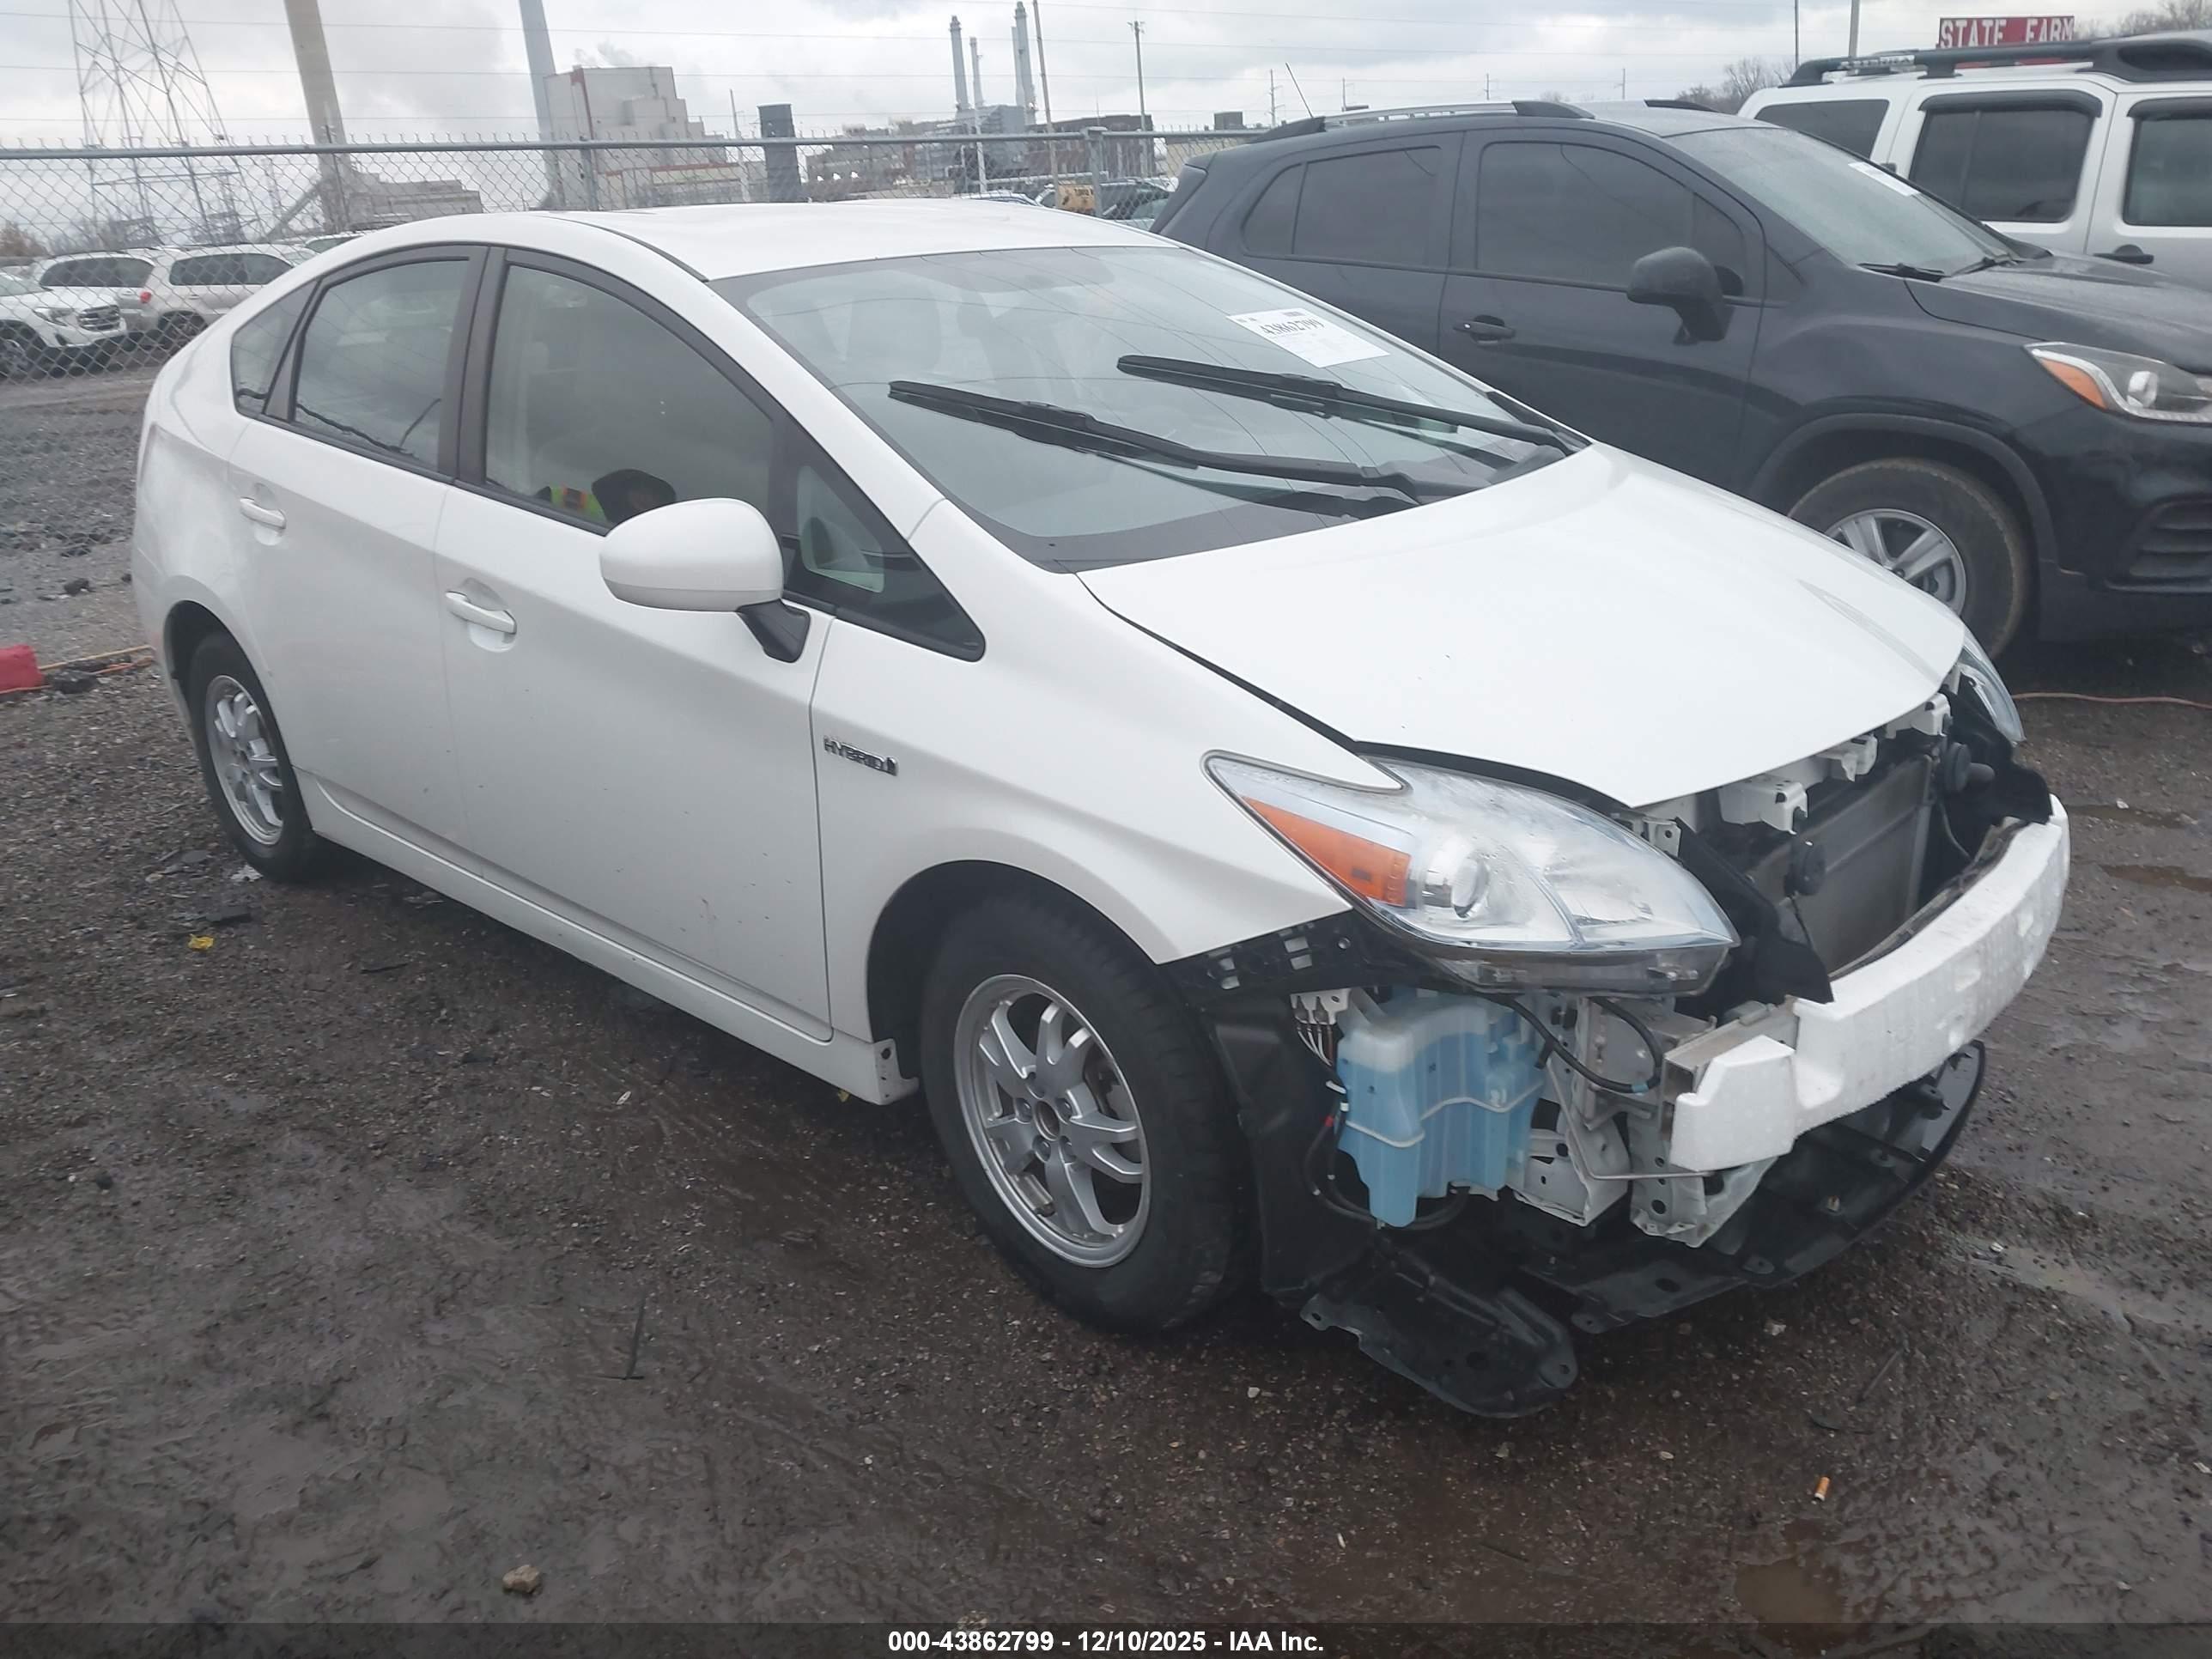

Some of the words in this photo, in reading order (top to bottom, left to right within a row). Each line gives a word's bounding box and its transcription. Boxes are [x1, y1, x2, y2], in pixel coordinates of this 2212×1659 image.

[1939, 19, 2008, 49] STATE
[2025, 17, 2075, 44] FARM
[823, 737, 885, 770] HYBRID
